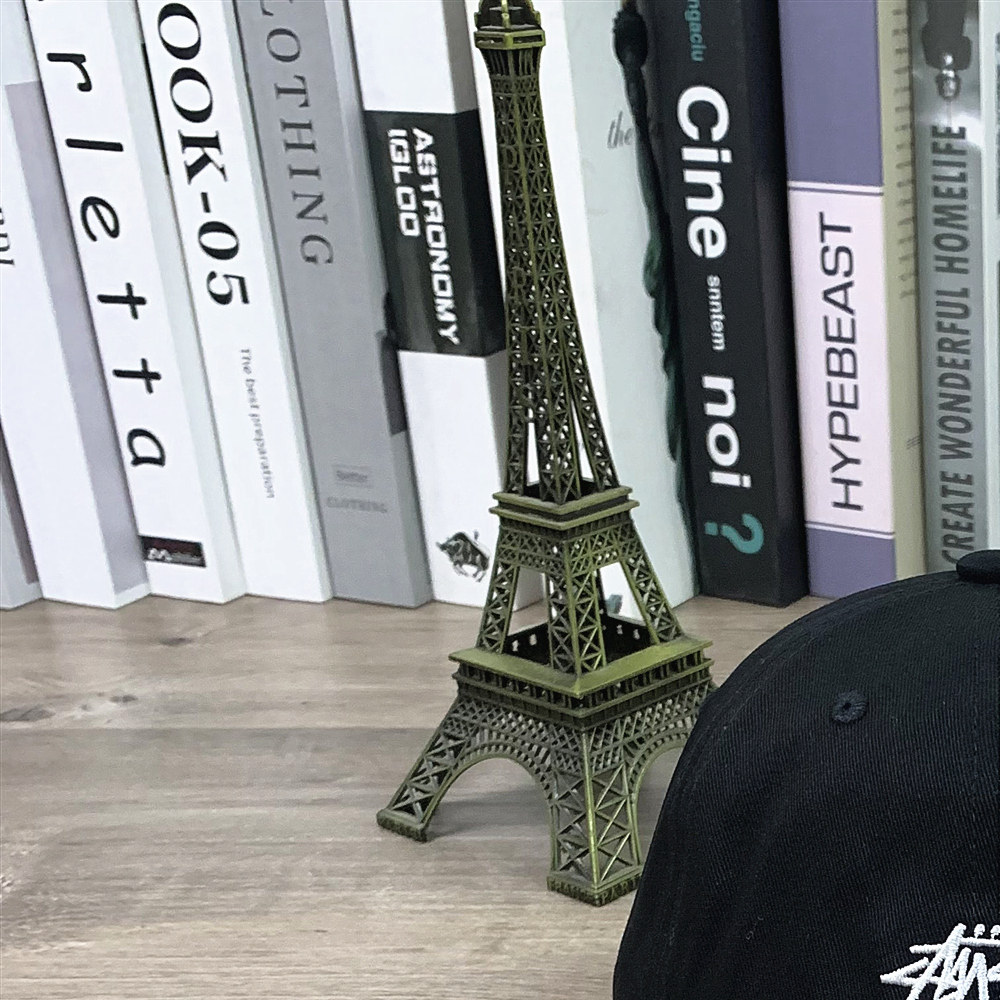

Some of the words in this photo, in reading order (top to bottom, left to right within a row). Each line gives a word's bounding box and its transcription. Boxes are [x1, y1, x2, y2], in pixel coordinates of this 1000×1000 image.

[157, 2, 250, 305] OOK-05
[387, 128, 421, 237] IGLOO
[606, 110, 635, 149] the
[676, 86, 732, 258] Cine
[931, 125, 968, 276] HOMELIFE
[411, 127, 460, 345] ASTRONOMY
[701, 375, 751, 489] noi
[818, 211, 863, 512] HYPEBEAST
[936, 287, 974, 460] WONDERFUL
